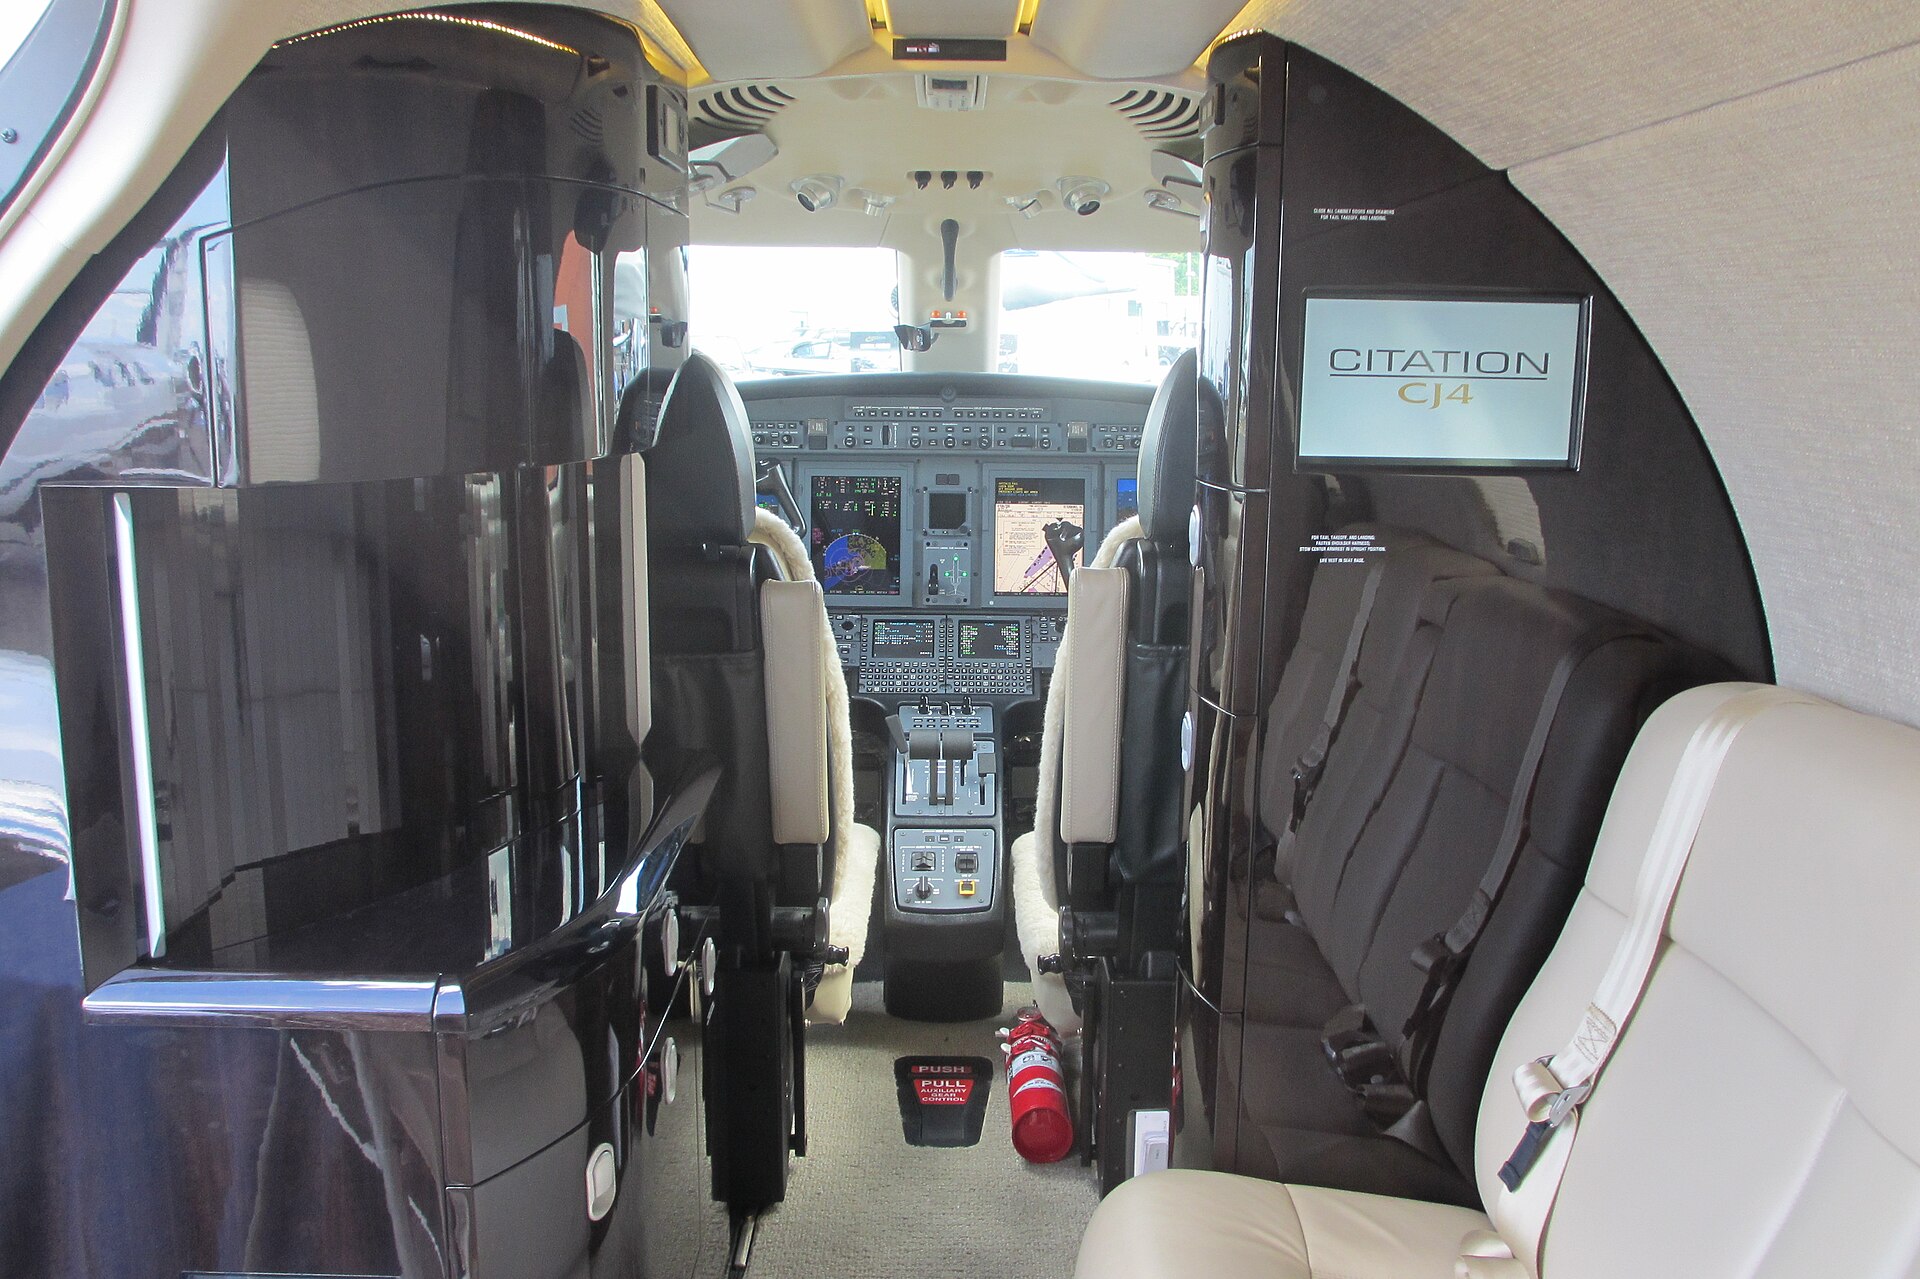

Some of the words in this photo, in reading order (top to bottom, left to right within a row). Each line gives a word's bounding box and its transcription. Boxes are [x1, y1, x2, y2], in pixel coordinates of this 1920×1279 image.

[1329, 348, 1550, 375] CITATION
[1397, 382, 1474, 410] CJ4
[921, 1080, 966, 1088] PULL
